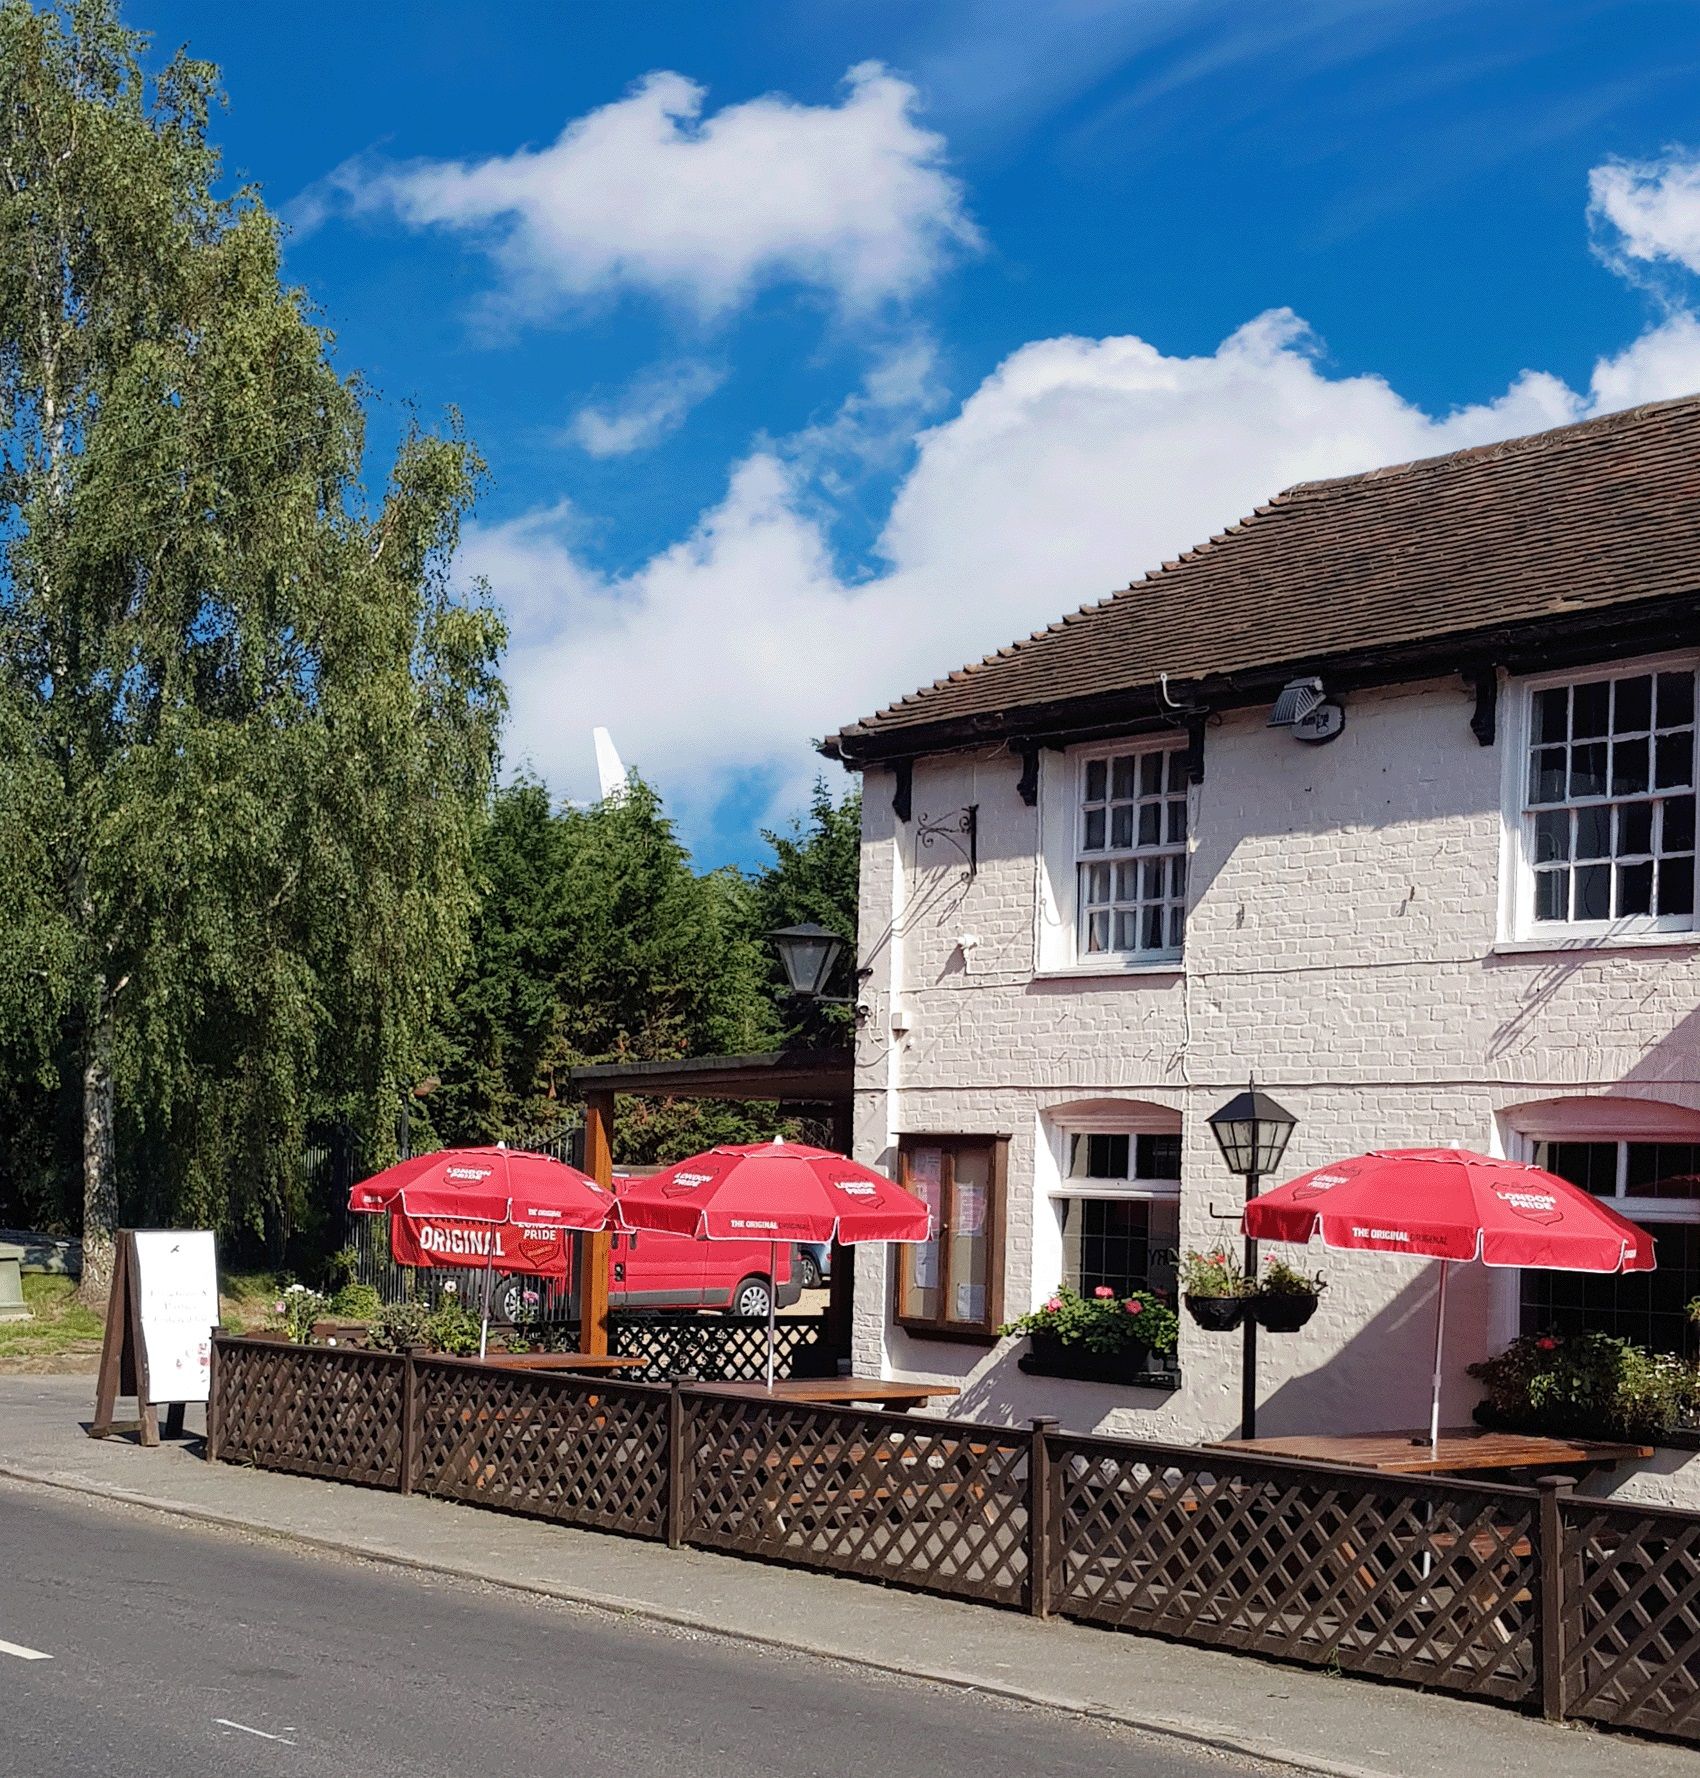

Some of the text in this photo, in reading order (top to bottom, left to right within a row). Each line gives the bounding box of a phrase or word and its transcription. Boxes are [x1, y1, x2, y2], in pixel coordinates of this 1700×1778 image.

[446, 1167, 492, 1177] LONDON
[1495, 1191, 1557, 1204] LONDON
[1510, 1200, 1554, 1211] PRIDE
[730, 1219, 745, 1228] THE
[745, 1220, 779, 1230] ORIGINAL
[523, 1229, 557, 1241] PRIDE
[1352, 1227, 1369, 1238] THE
[1370, 1229, 1410, 1242] ORIGINAL
[419, 1225, 506, 1257] ORIGINAL
